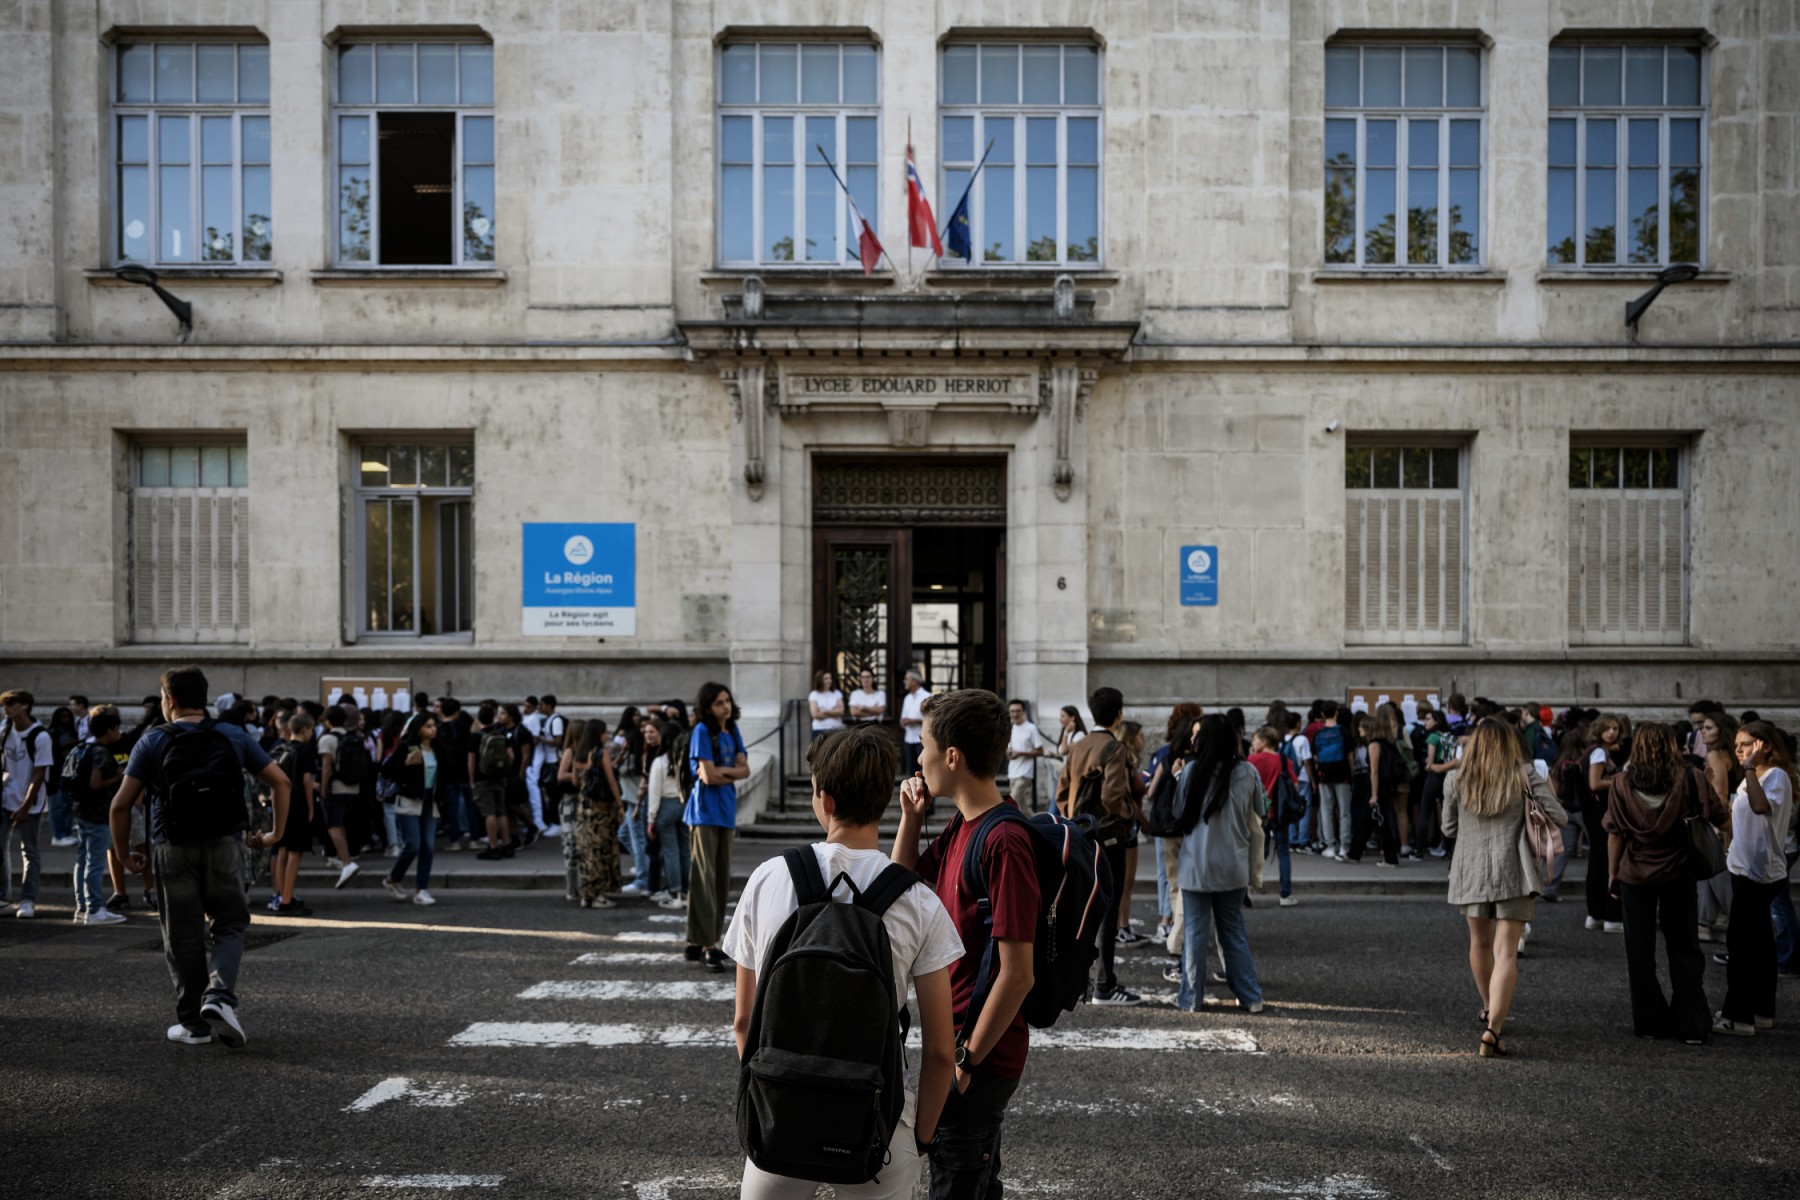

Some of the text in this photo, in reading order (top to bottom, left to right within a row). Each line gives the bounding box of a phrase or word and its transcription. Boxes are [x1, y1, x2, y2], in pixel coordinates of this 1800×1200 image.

[805, 378, 1011, 393] LYCEE EDOUARD HERRIOT
[545, 571, 613, 587] La Région
[1057, 576, 1067, 590] 6
[561, 611, 591, 619] Région
[593, 611, 609, 619] agit
[582, 620, 614, 628] lycéens
